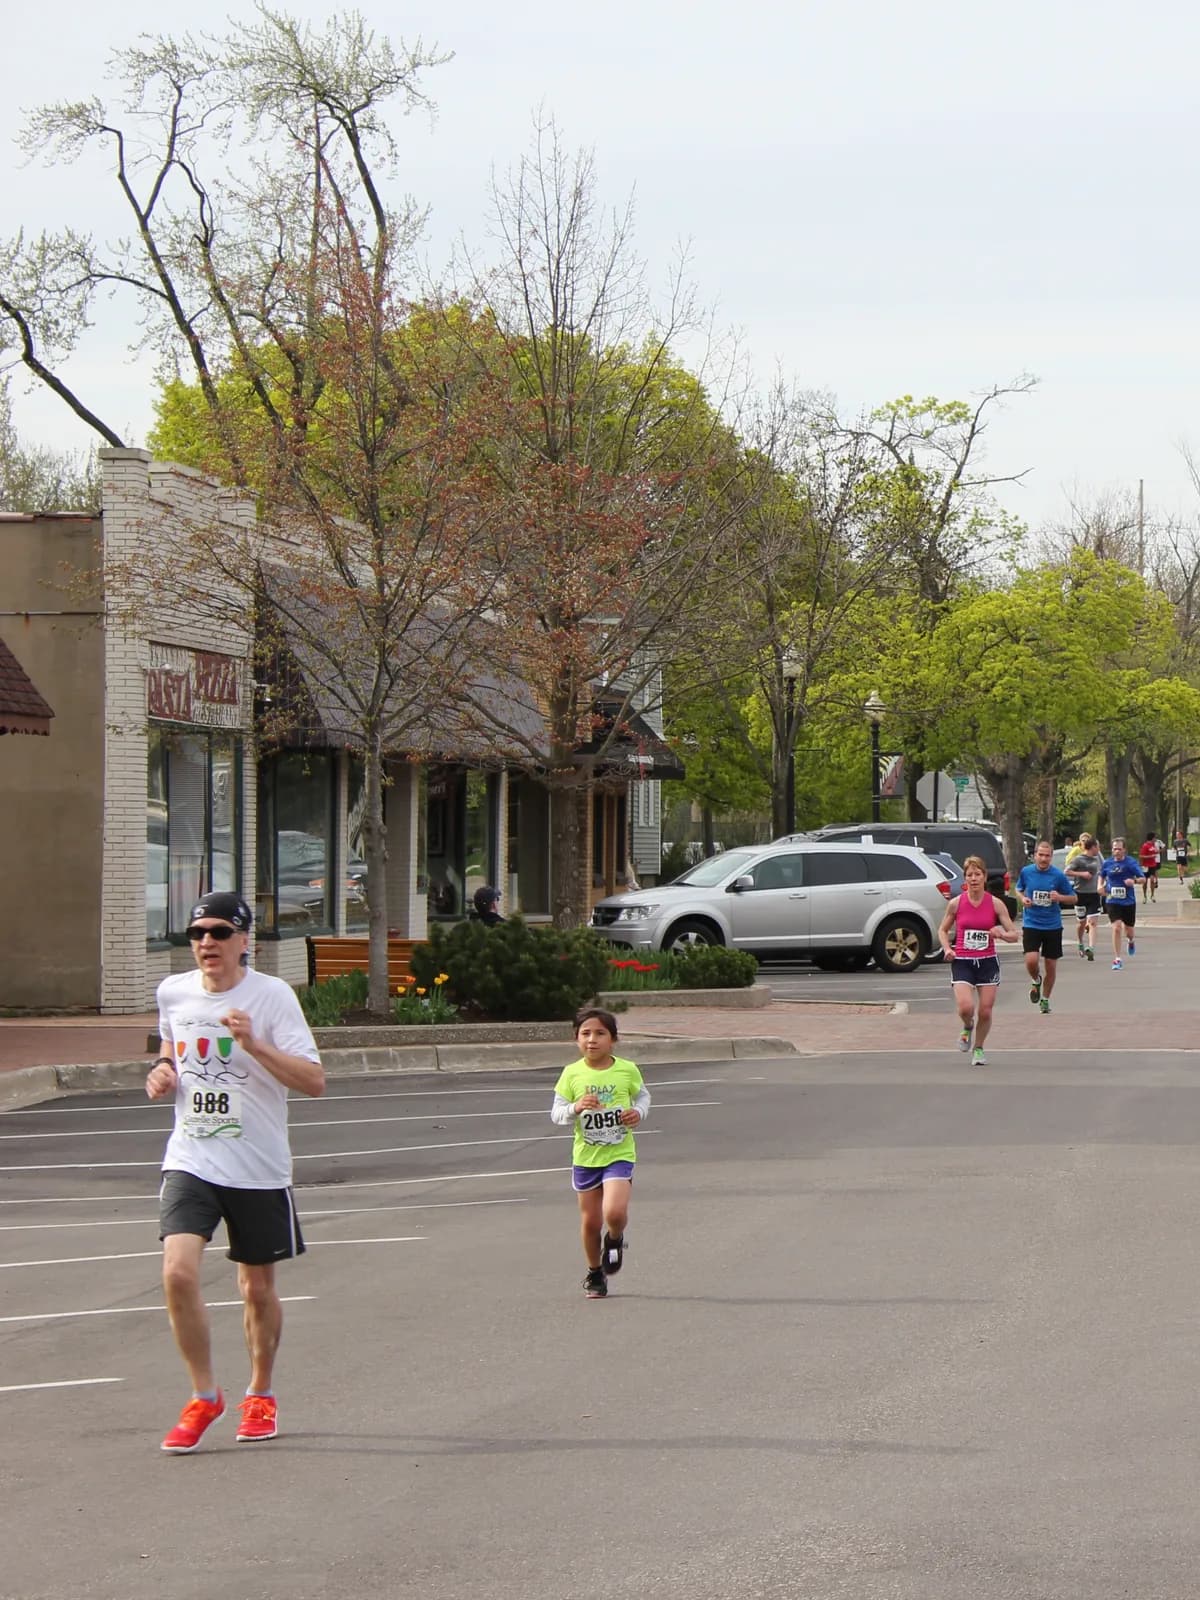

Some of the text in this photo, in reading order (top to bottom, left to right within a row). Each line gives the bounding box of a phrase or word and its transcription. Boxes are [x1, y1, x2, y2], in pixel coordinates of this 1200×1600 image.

[590, 1084, 616, 1094] PLAY
[193, 1092, 229, 1115] 988
[212, 1115, 240, 1126] Sports
